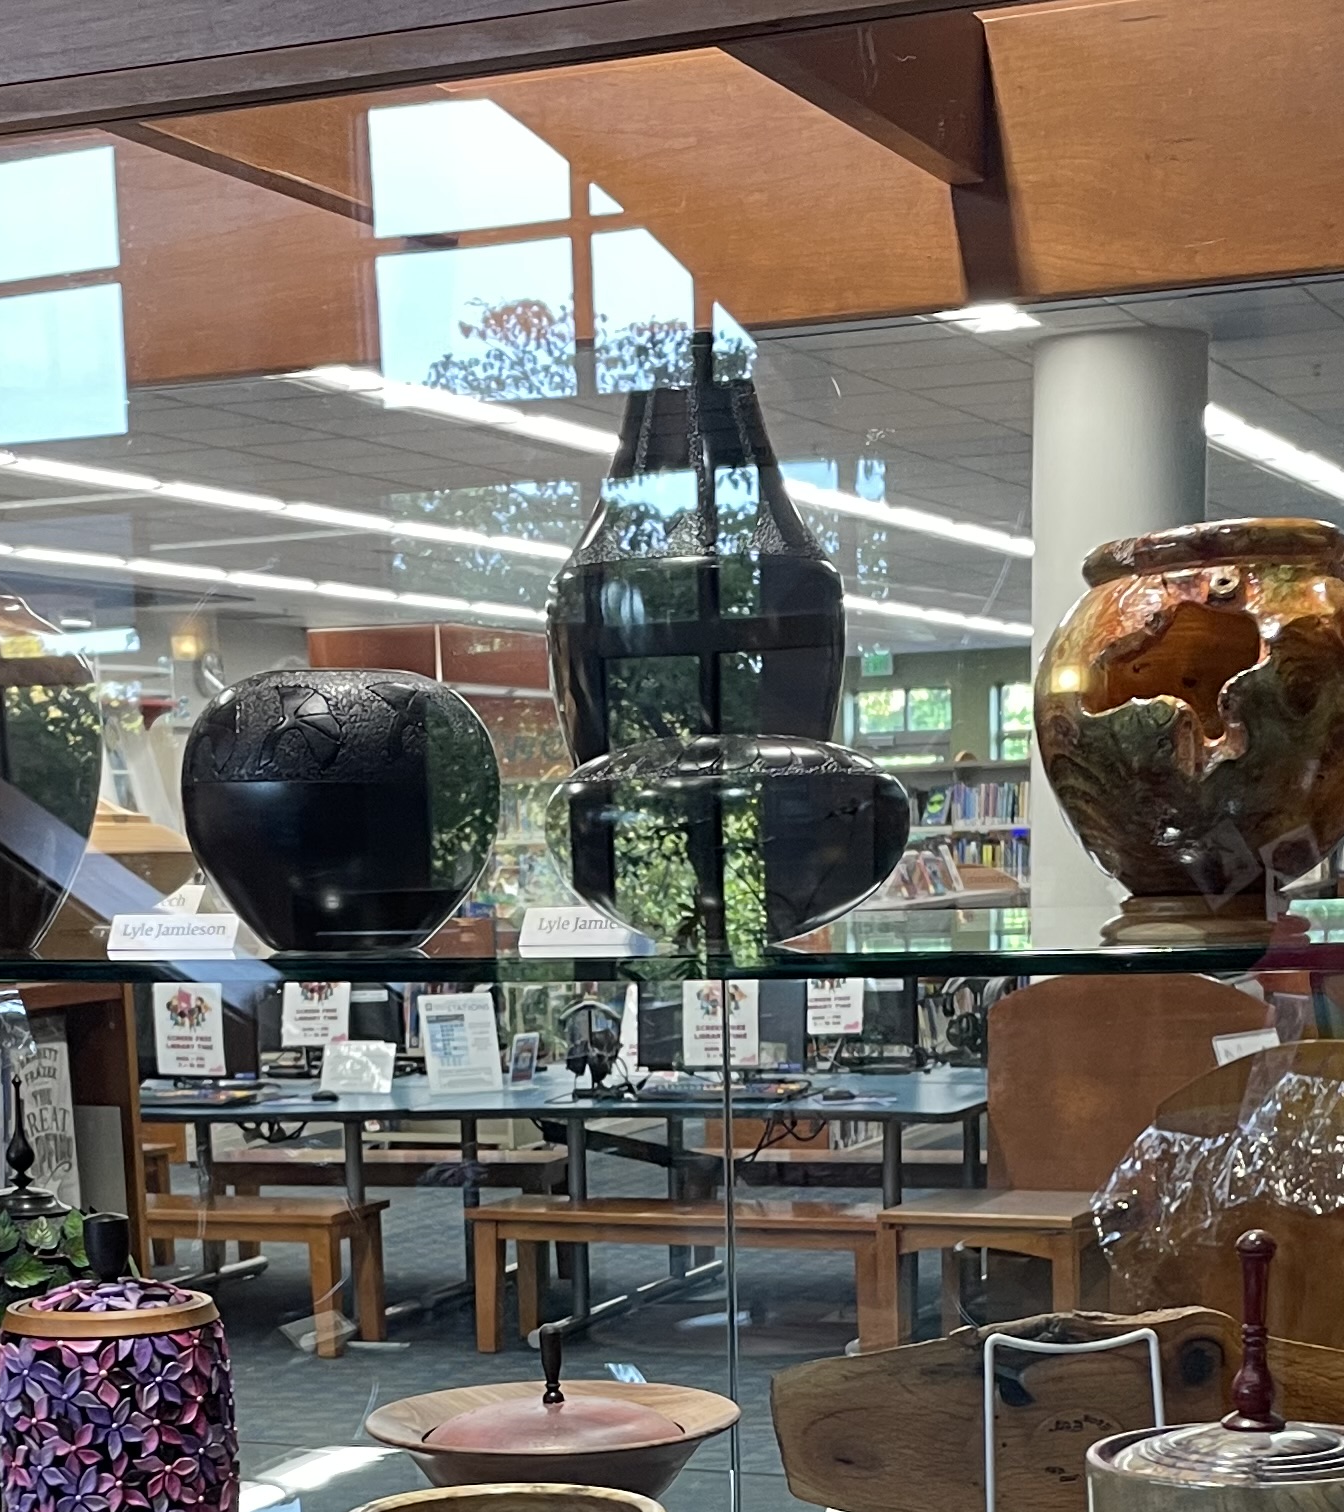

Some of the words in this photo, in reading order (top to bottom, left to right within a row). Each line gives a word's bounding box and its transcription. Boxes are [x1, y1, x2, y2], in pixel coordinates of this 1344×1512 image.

[122, 923, 154, 939] Lyle
[155, 923, 226, 938] Jamieson
[537, 917, 571, 934] Lyle
[23, 1106, 70, 1138] REAT
